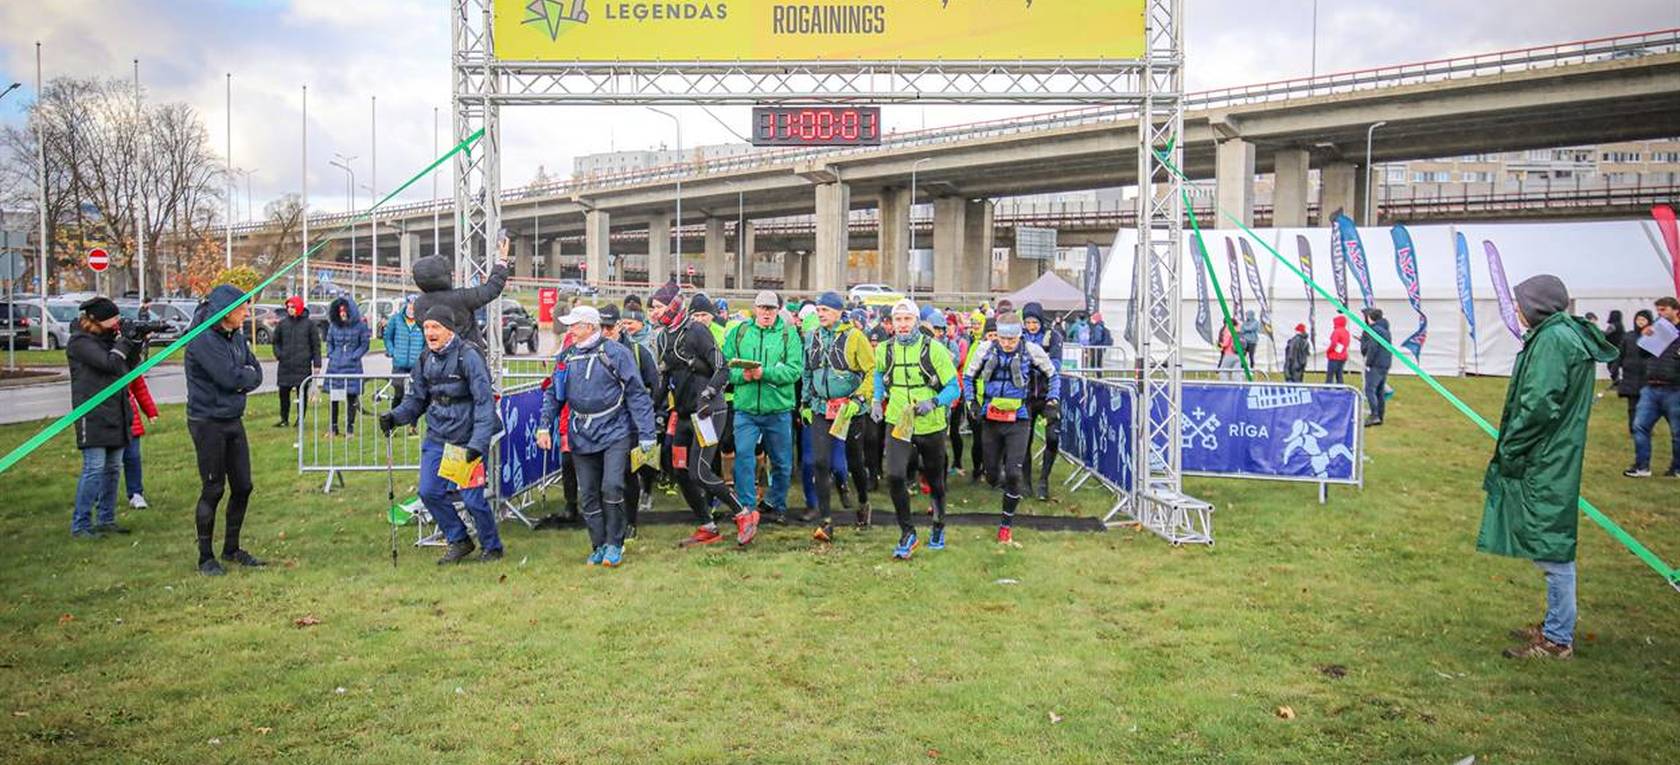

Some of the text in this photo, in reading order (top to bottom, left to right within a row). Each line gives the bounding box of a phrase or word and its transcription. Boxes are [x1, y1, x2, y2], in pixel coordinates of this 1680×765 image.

[605, 3, 728, 22] LEĢENDAS
[773, 5, 885, 34] ROGAININGS
[768, 111, 876, 139] 11:00:01
[1228, 422, 1269, 439] RĪGA
